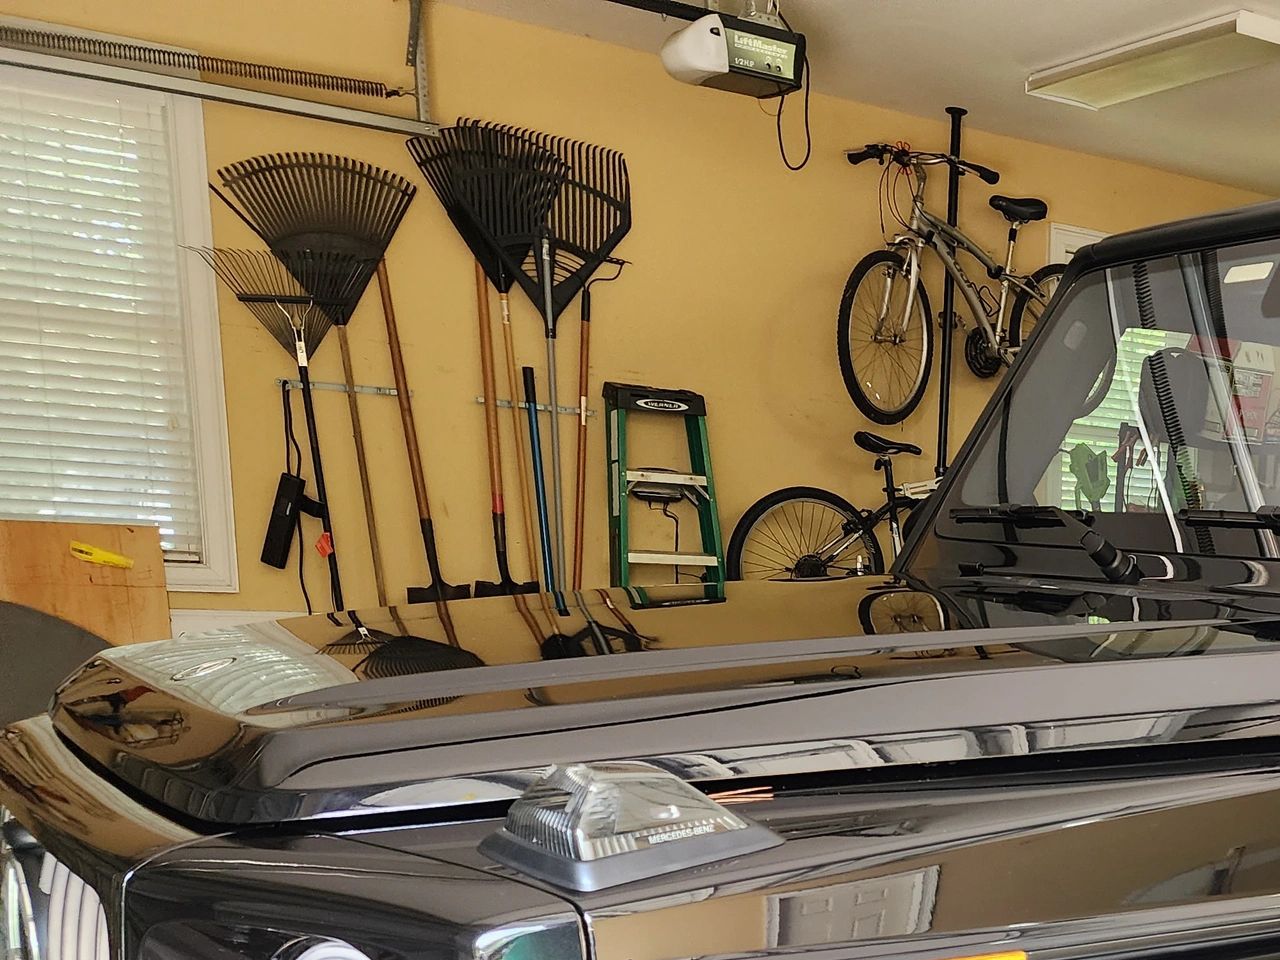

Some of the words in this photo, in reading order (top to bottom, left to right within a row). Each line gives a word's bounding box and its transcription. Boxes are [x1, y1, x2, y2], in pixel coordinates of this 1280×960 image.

[734, 34, 788, 54] LiftMaster
[648, 401, 678, 409] WERNER
[647, 824, 715, 845] MERCEDES-BENZ
